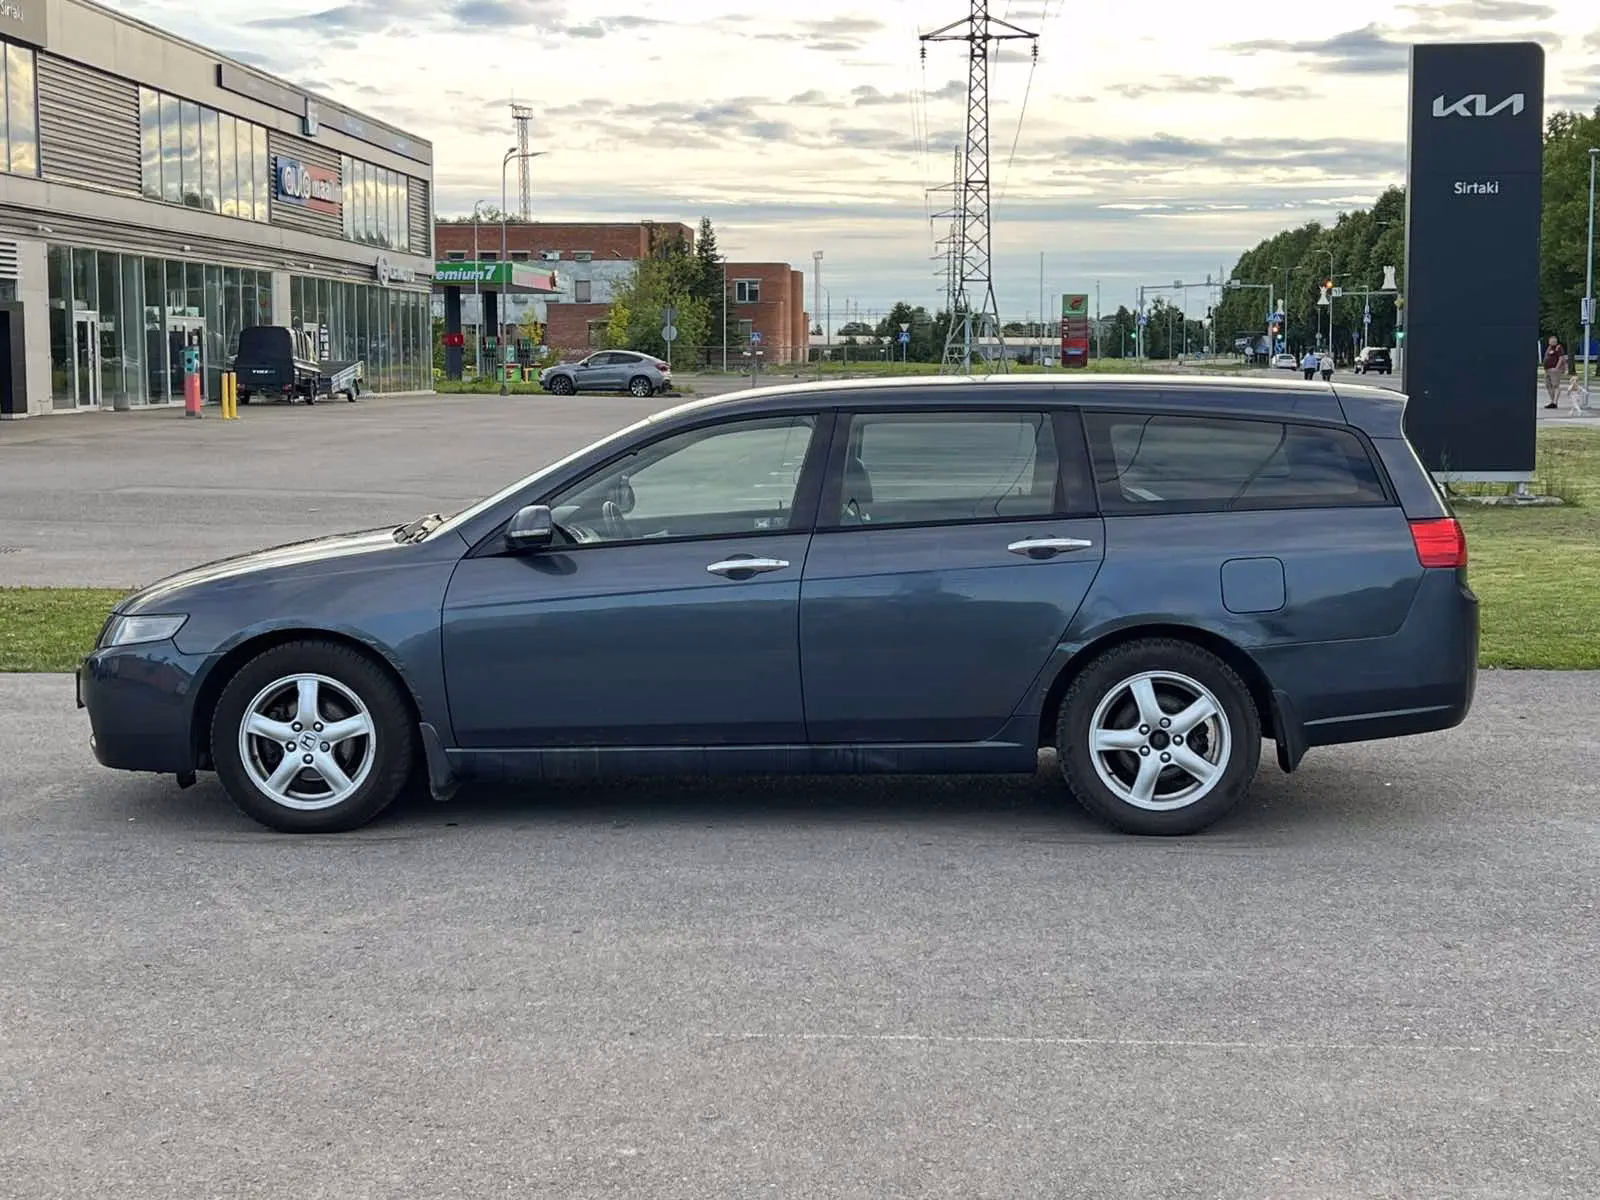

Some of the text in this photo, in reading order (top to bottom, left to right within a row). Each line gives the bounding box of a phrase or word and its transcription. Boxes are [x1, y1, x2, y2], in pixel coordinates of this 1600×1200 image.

[1433, 93, 1524, 117] KIA
[1454, 181, 1499, 194] Sirtaki
[435, 265, 496, 281] emium7
